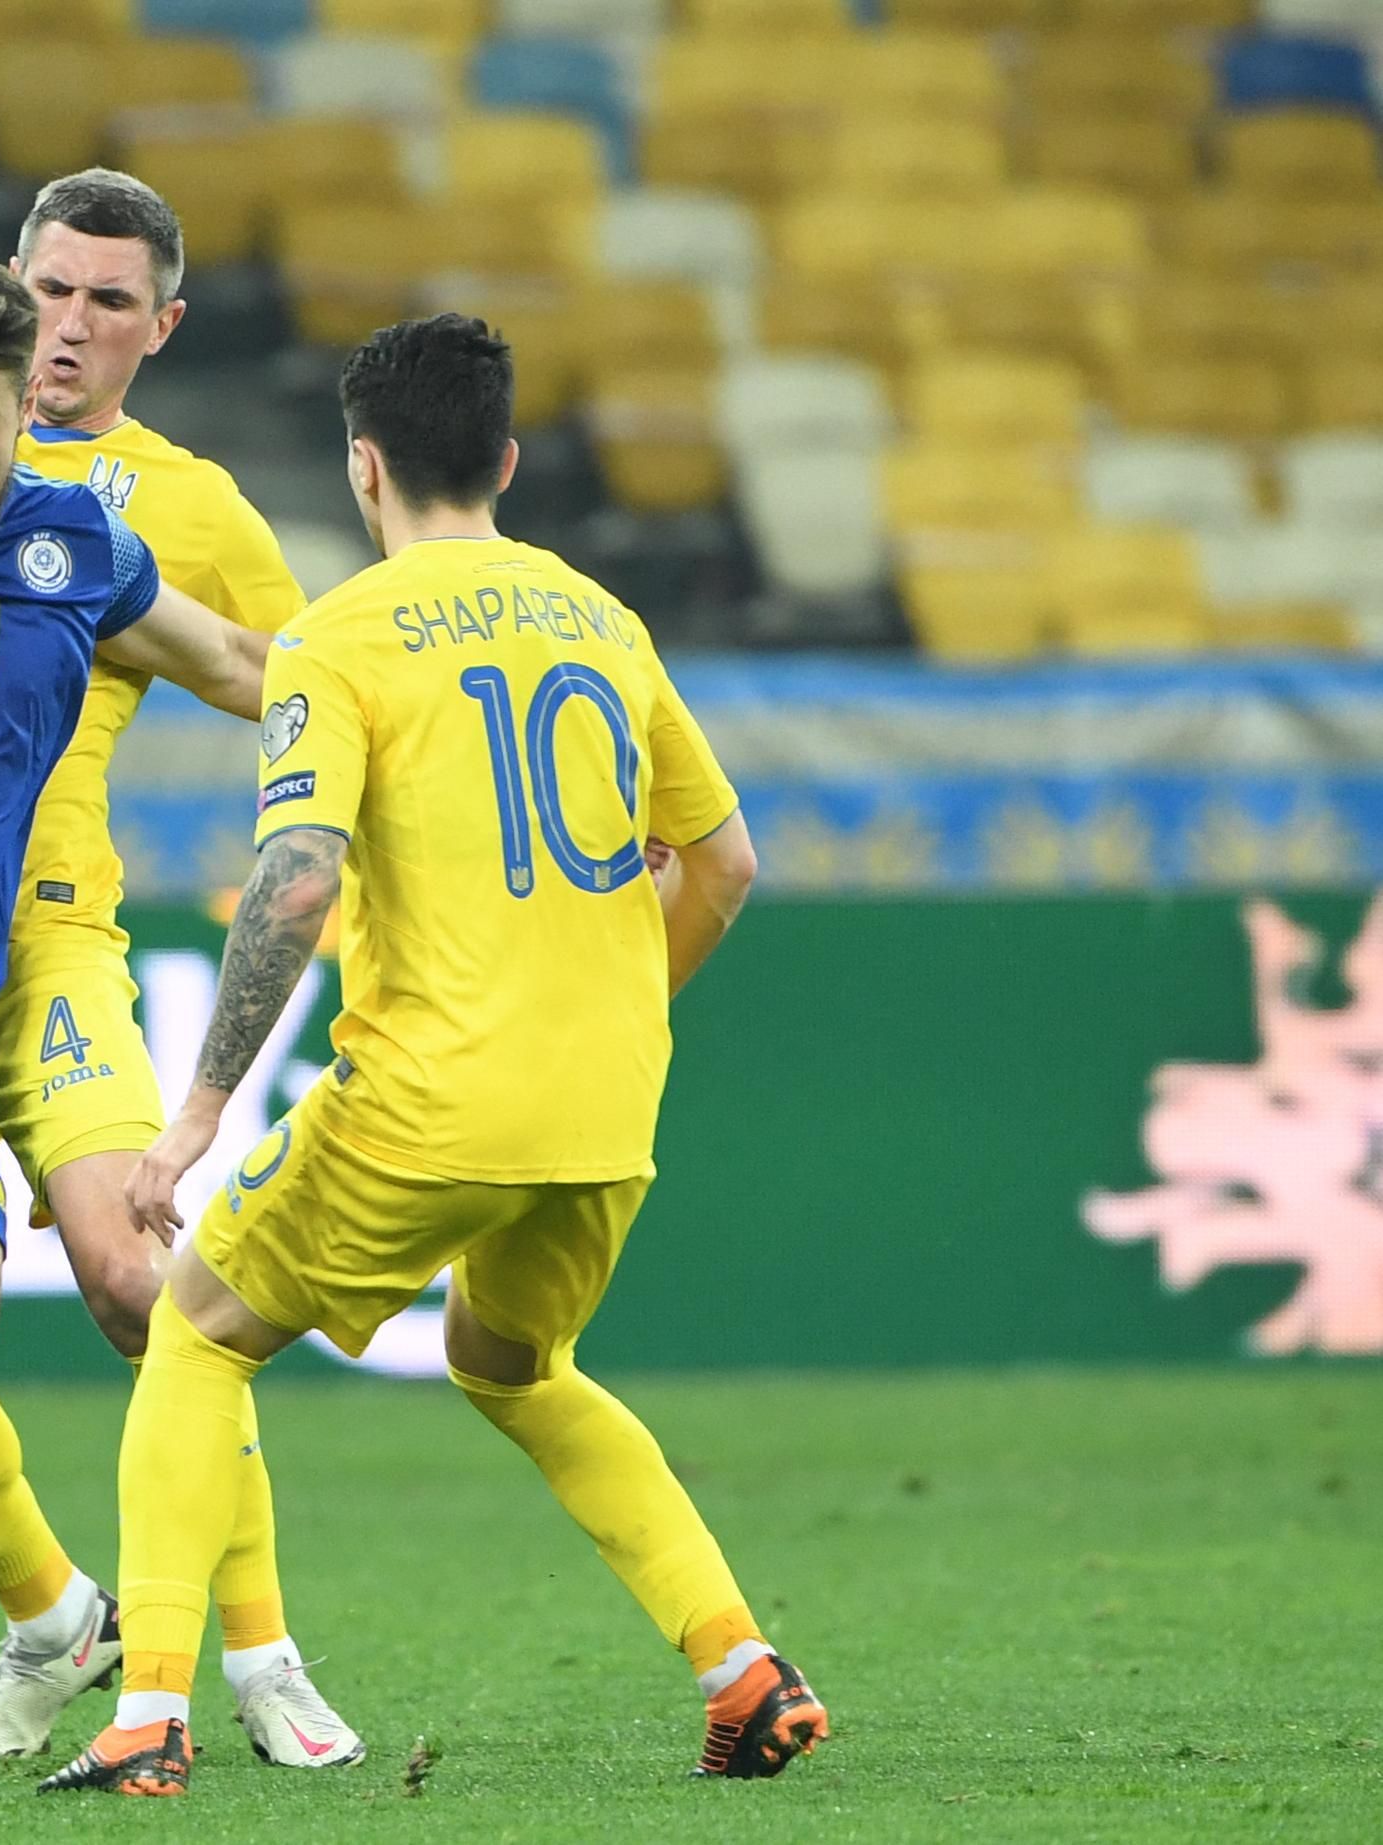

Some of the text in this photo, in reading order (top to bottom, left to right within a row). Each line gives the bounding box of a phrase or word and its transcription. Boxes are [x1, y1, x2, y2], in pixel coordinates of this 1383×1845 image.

[392, 584, 636, 653] SHAPARENKO
[460, 662, 646, 899] 10
[40, 996, 92, 1064] 4
[41, 1063, 115, 1103] joma
